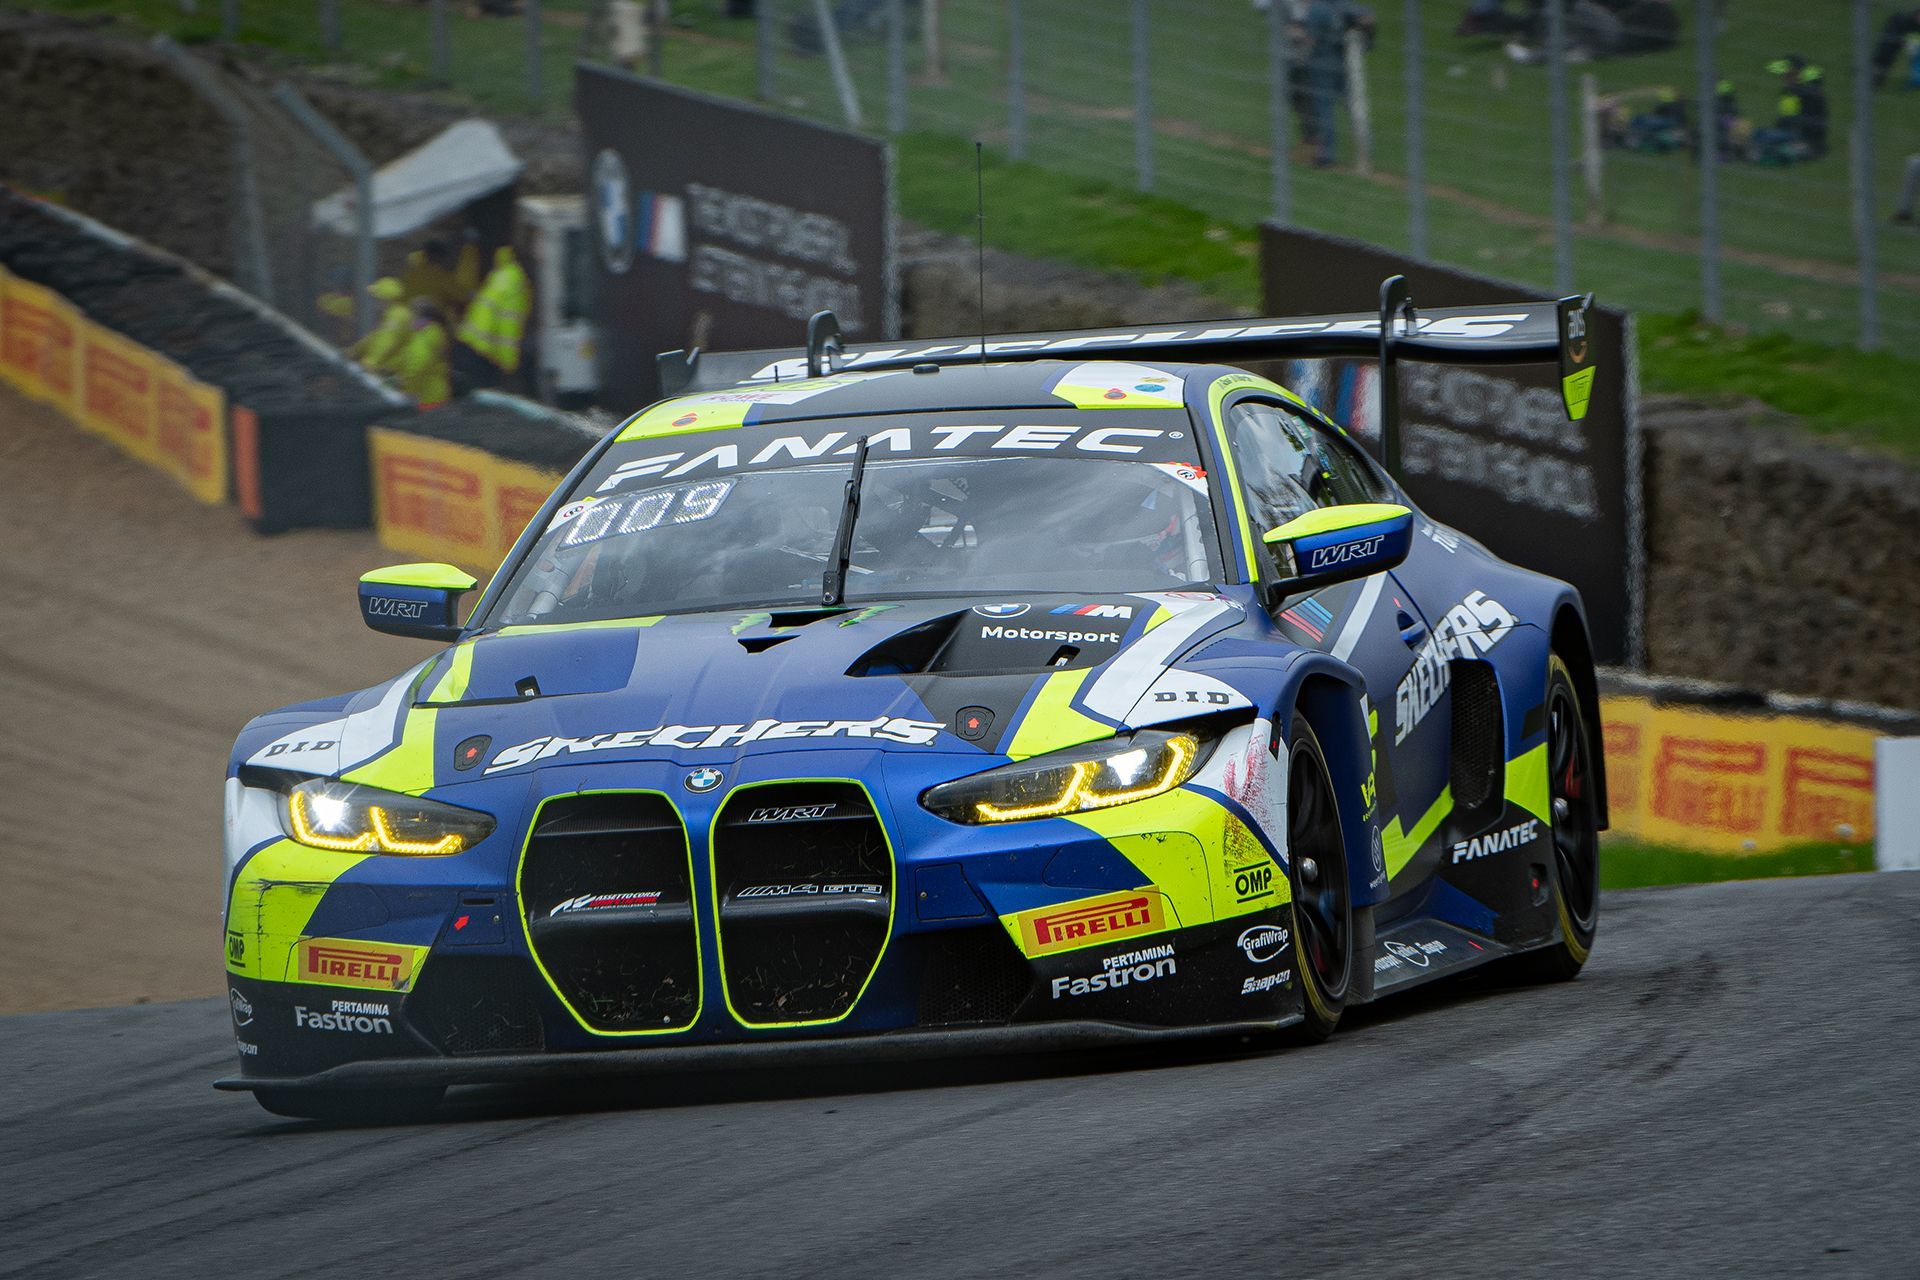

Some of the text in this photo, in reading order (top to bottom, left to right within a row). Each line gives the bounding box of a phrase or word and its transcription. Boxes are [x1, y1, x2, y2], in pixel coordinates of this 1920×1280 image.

[595, 425, 1165, 492] FANATEC
[564, 482, 730, 545] 009
[1311, 534, 1385, 569] WRT
[369, 597, 429, 618] WRT
[981, 626, 1121, 643] Motorsport
[1395, 590, 1515, 747] SKECHERS
[483, 716, 948, 775] SKECHERS
[748, 803, 836, 822] WRT
[1452, 819, 1538, 864] FANATEC
[823, 884, 882, 895] GT3
[1235, 867, 1272, 896] OMP
[1034, 897, 1150, 945] PIRELLI
[227, 936, 245, 960] OMP
[1243, 928, 1288, 952] GrafiWrap
[308, 946, 403, 983] PIRELLI
[1103, 944, 1175, 970] PERTAMINA
[1052, 958, 1176, 999] Fastron
[294, 1006, 394, 1034] Fastron
[332, 1000, 390, 1016] PERTAMINA
